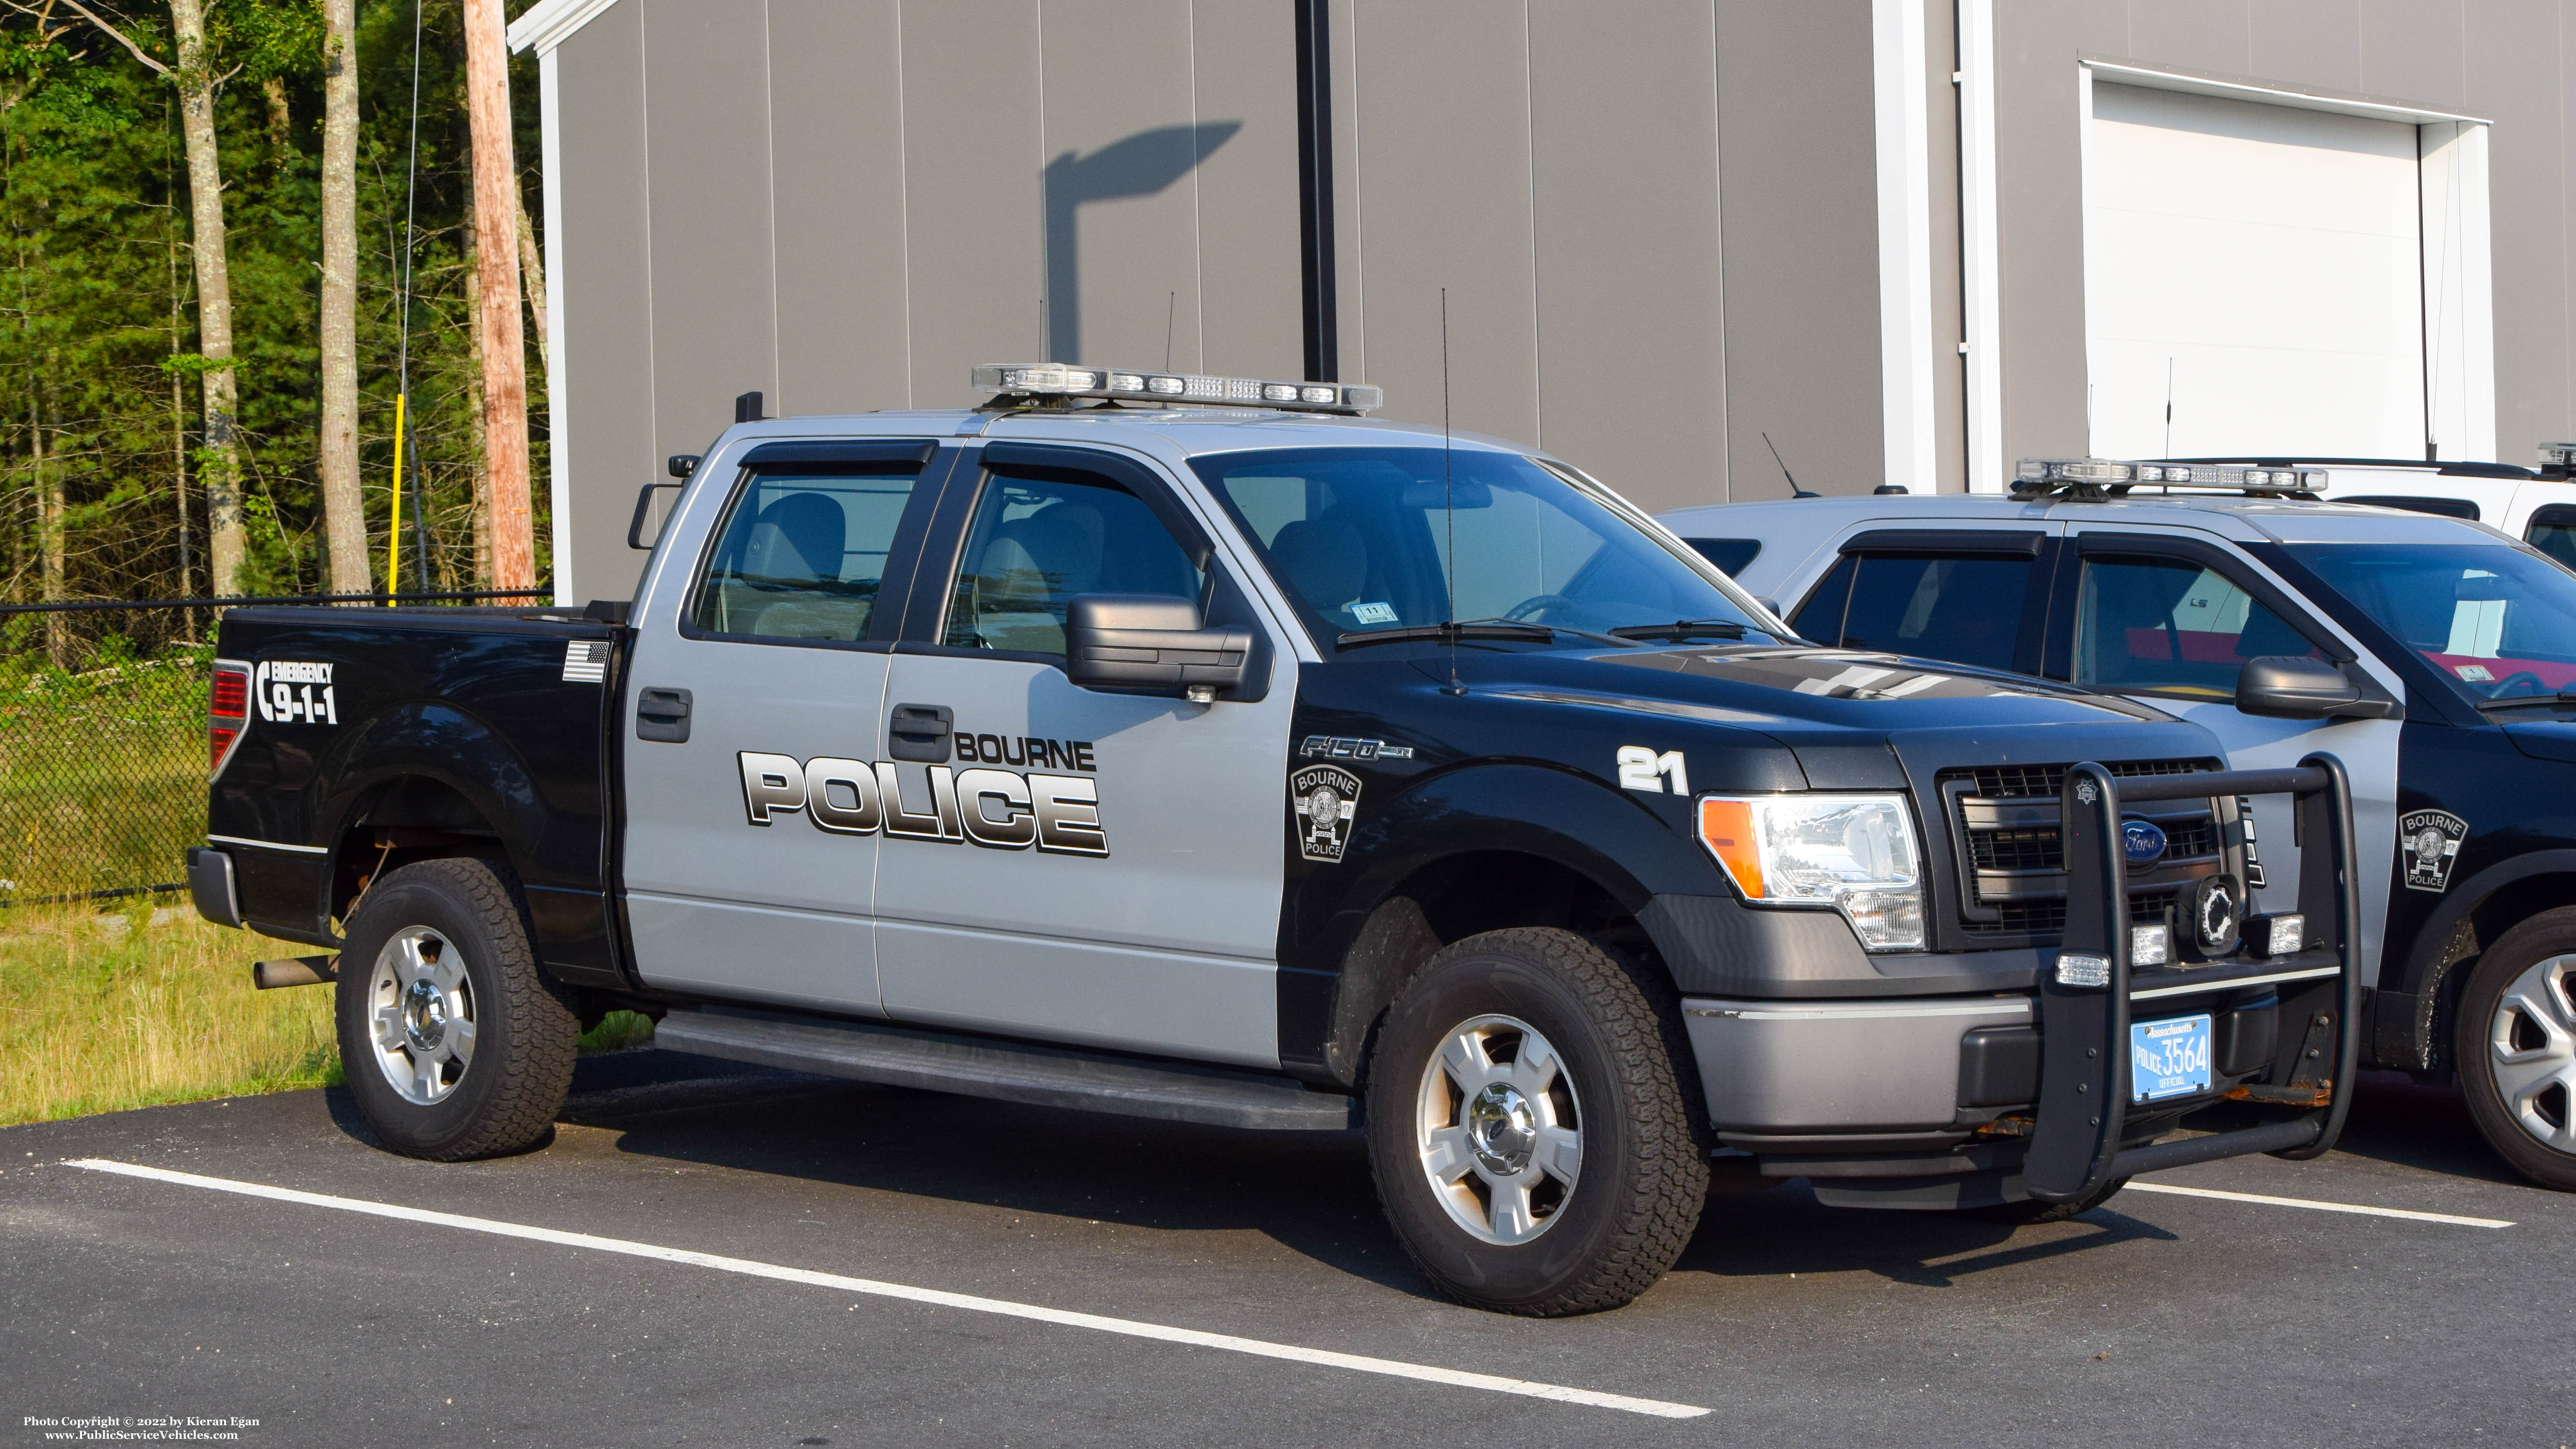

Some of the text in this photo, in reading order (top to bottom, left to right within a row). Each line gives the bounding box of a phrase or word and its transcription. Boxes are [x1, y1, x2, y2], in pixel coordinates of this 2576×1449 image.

[271, 661, 334, 684] EMERGENCY
[273, 683, 338, 725] 9-1-1
[954, 732, 1097, 772] BOURNE
[1617, 745, 1690, 796] 21
[1297, 771, 1356, 795] BOURNE
[736, 750, 1111, 859] POLICE
[2406, 815, 2463, 835] BOURNE
[1305, 843, 1341, 856] POLICE
[2126, 828, 2158, 852] Ford
[2409, 875, 2443, 887] POLICE
[2147, 1023, 2192, 1039] Massachusetts
[2136, 1035, 2207, 1077] POLICE 3564
[2159, 1077, 2185, 1088] OFFICIAL
